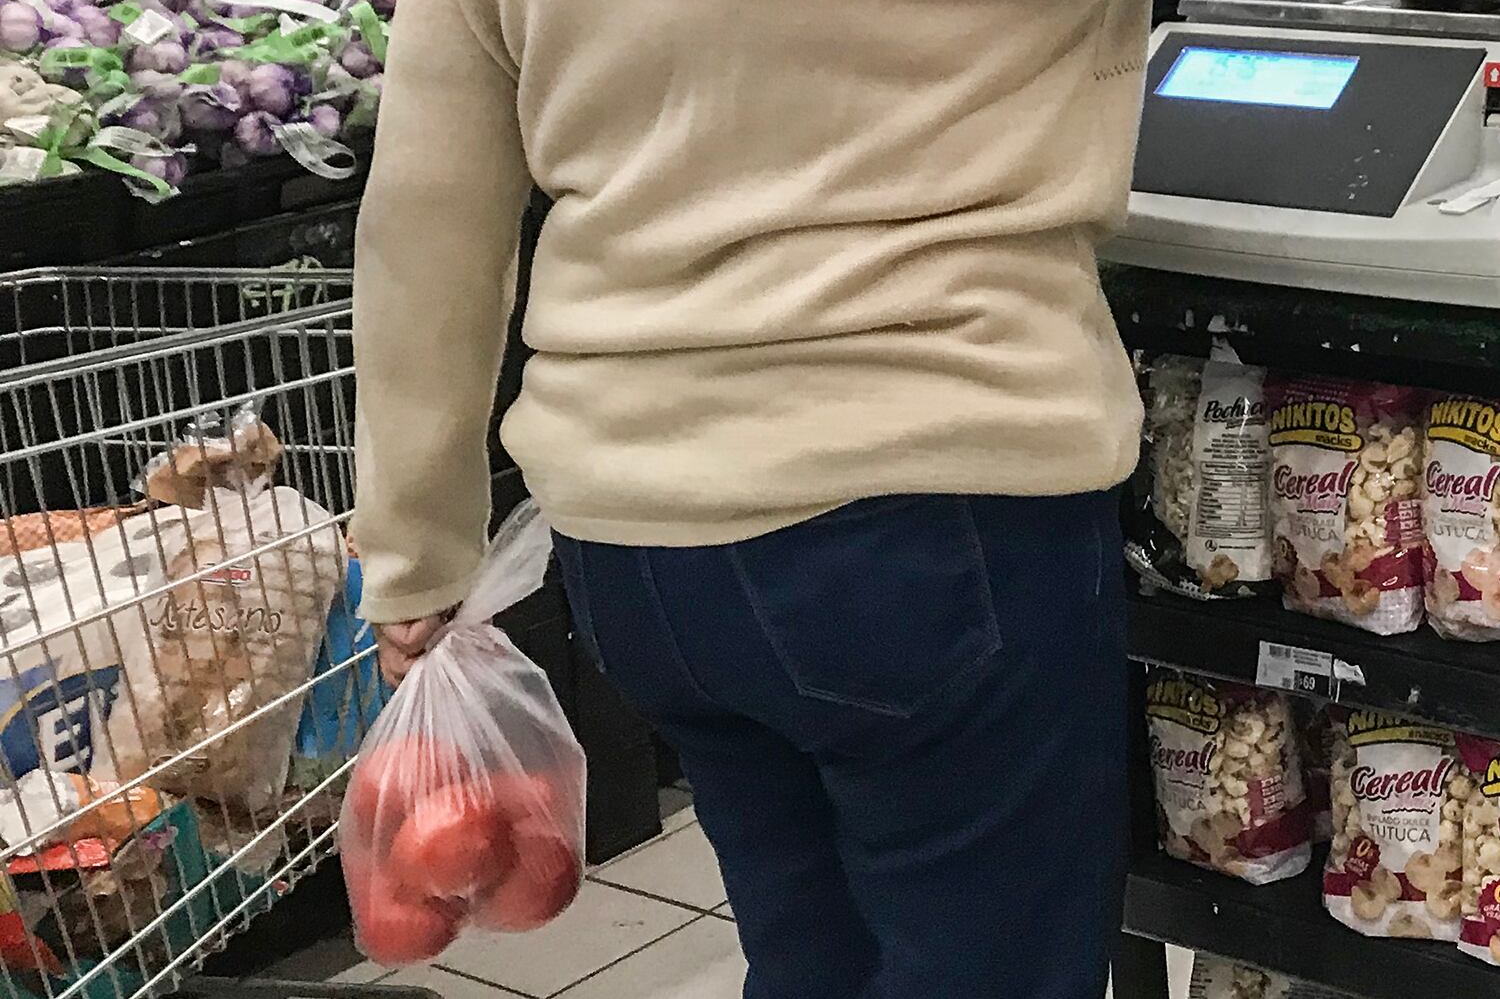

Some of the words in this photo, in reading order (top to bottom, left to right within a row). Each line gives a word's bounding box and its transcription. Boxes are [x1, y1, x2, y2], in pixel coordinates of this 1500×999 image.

[1273, 460, 1358, 497] Cereal
[1351, 757, 1455, 797] Cereal
[1370, 822, 1431, 843] TUTUCA
